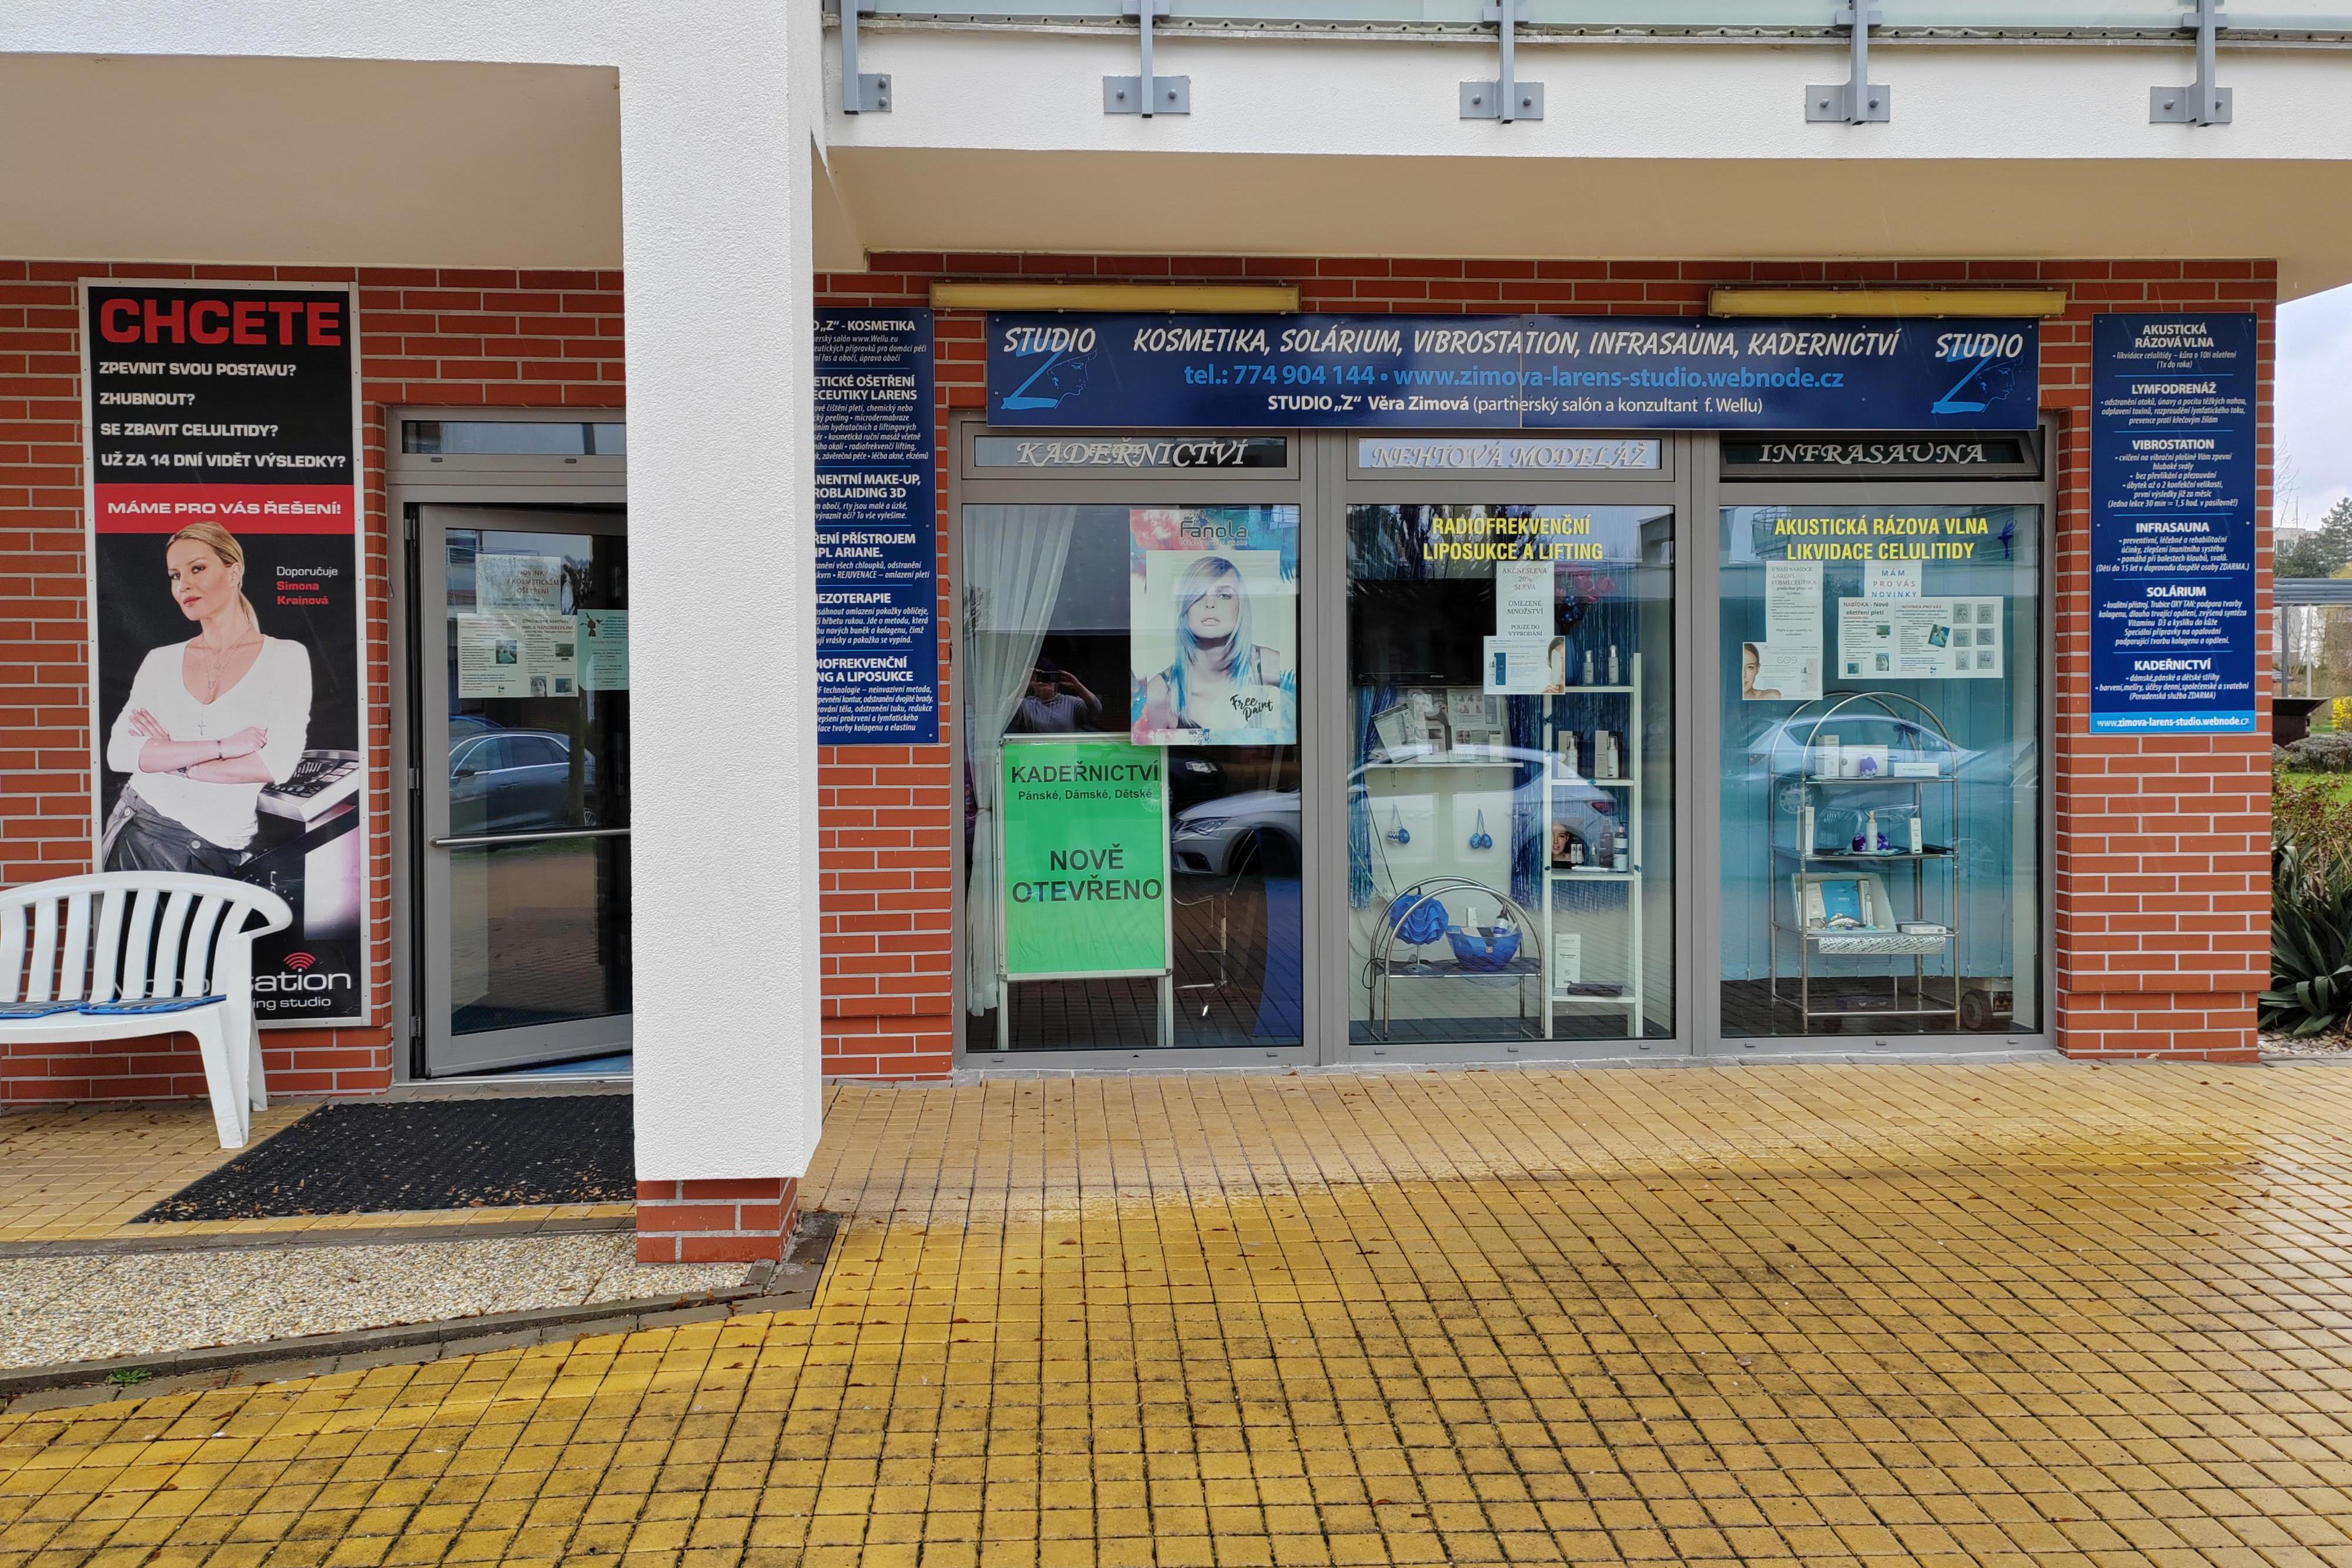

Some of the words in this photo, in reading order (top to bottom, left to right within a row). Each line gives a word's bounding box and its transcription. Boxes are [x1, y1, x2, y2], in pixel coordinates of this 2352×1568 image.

[101, 299, 341, 346] CHCETE
[848, 320, 916, 331] KOSMETIKA
[2143, 323, 2206, 335] AKUSTICKÁ
[1003, 327, 1095, 353] STUDIO
[1133, 328, 1270, 356] KOSMETIKA,
[1280, 325, 1402, 356] SOLÁRIUM,
[1414, 330, 1581, 359] VIBROSTATION,
[1589, 332, 1740, 359] INFRASAUNA,
[1935, 333, 2023, 359] STUDIO
[2136, 336, 2182, 348] RÁZOVÁ
[2183, 337, 2214, 347] VLNA
[99, 362, 166, 375] ZPEVNIT
[169, 362, 212, 375] SVOU
[216, 363, 296, 376] POSTAVU?
[1184, 363, 1228, 385] tel.:
[1234, 365, 1277, 385] 774
[1282, 365, 1326, 385] 904
[1333, 366, 1375, 385] 144
[1393, 365, 1845, 388] www.zimova-larens-studio.webnode.cz
[857, 375, 915, 387] OŠETŘENÍ
[2132, 382, 2217, 394] LYMFODRENÁŽ
[99, 393, 195, 406] ZHUBNOUT?
[871, 390, 917, 400] LARENS
[1268, 395, 1332, 410] STUDIO
[1368, 395, 1404, 410] Věra
[1408, 396, 1469, 411] Zimová
[1474, 396, 1559, 415] (partnerský
[1562, 397, 1602, 412] salón
[1606, 401, 1614, 412] a
[1618, 397, 1698, 412] konzultant
[1716, 397, 1763, 414] Wellu)
[101, 423, 121, 435] SE
[124, 423, 179, 436] ZBAVIT
[182, 424, 278, 437] CELULITIDY?
[2132, 439, 2214, 450] VIBROSTATION
[1016, 437, 1249, 467] KADEŘNICTVÍ
[1371, 441, 1504, 469] NEHTOVÁ
[1510, 440, 1649, 469] MODELÁŽ
[1759, 442, 1987, 465] INFRASAUNA
[101, 452, 123, 466] UŽ
[126, 454, 146, 466] ZA
[151, 454, 170, 466] 14
[173, 452, 202, 467] DNÍ
[206, 452, 251, 467] VIDĚT
[255, 453, 346, 468] VÝSLEDKY?
[864, 474, 921, 486] MAKE-UP,
[890, 488, 906, 498] 3D
[108, 500, 171, 513] MÁME
[175, 503, 216, 514] PRO
[219, 500, 260, 514] VÁS
[264, 500, 341, 514] ŘEŠENÍ!
[1180, 520, 1247, 538] Fanola
[1432, 513, 1592, 535] RADIOFREKVENČNÍ
[1775, 514, 1867, 536] AKUSTICKÁ
[1873, 514, 1940, 535] RÁZOVA
[1944, 517, 1989, 534] VLNA
[2136, 522, 2210, 533] INFRASAUNA
[842, 531, 916, 544] PŘÍSTROJEM
[835, 547, 883, 557] ARIANE.
[1423, 543, 1518, 560] LIPOSUKCE
[1522, 544, 1534, 560] A
[1539, 543, 1603, 560] LIFTING
[1788, 543, 1873, 560] LIKVIDACE
[1878, 543, 1975, 559] CELULITIDY
[276, 566, 338, 578] Doporučuje
[276, 581, 319, 591] Simona
[2147, 584, 2206, 597] SOLÁRIUM
[277, 595, 329, 606] Krainová
[2134, 658, 2211, 671] KADEŘNICTVÍ
[836, 672, 845, 682] A
[848, 671, 913, 682] LIPOSUKCE
[1230, 694, 1259, 710] Free
[1011, 760, 1159, 783] KADEŘNICTVÍ
[1018, 791, 1061, 801] Pánské,
[1065, 789, 1111, 800] Dámské,
[1115, 788, 1152, 799] Dětské
[1050, 842, 1124, 871] NOVĚ
[1012, 874, 1162, 904] OTEVŘENO
[252, 968, 351, 992] ation
[280, 997, 331, 1007] studio
